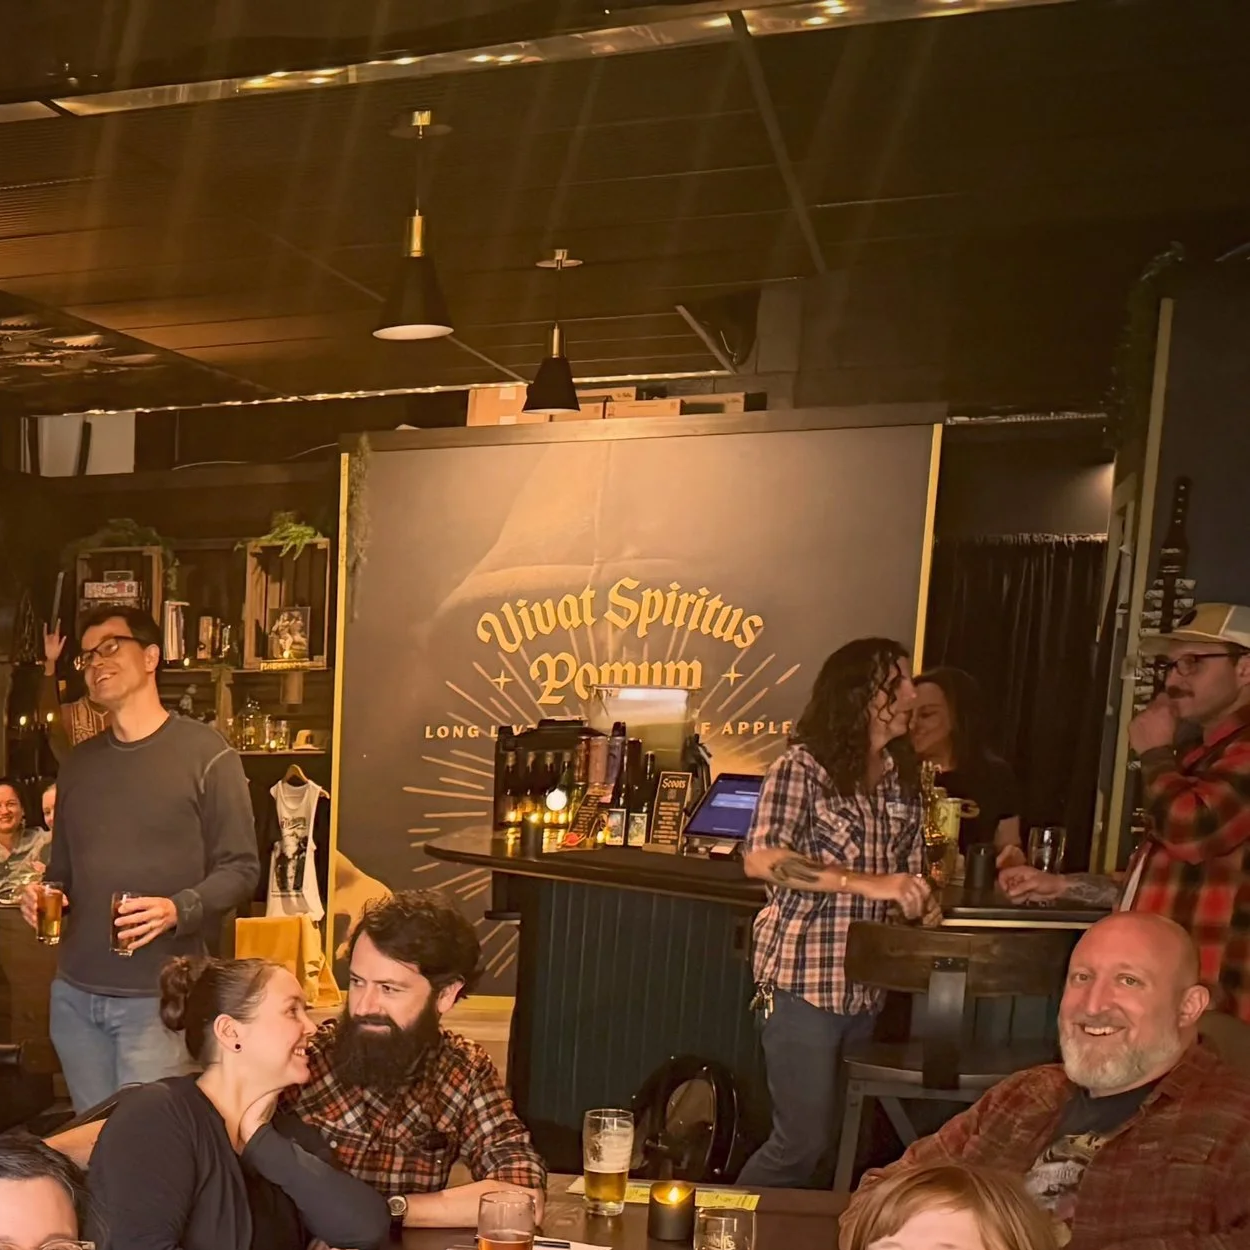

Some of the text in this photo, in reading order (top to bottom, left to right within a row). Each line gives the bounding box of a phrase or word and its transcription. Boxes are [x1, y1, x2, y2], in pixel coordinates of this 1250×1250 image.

[477, 577, 764, 654] Vivat Spiritus
[424, 725, 479, 739] LONG
